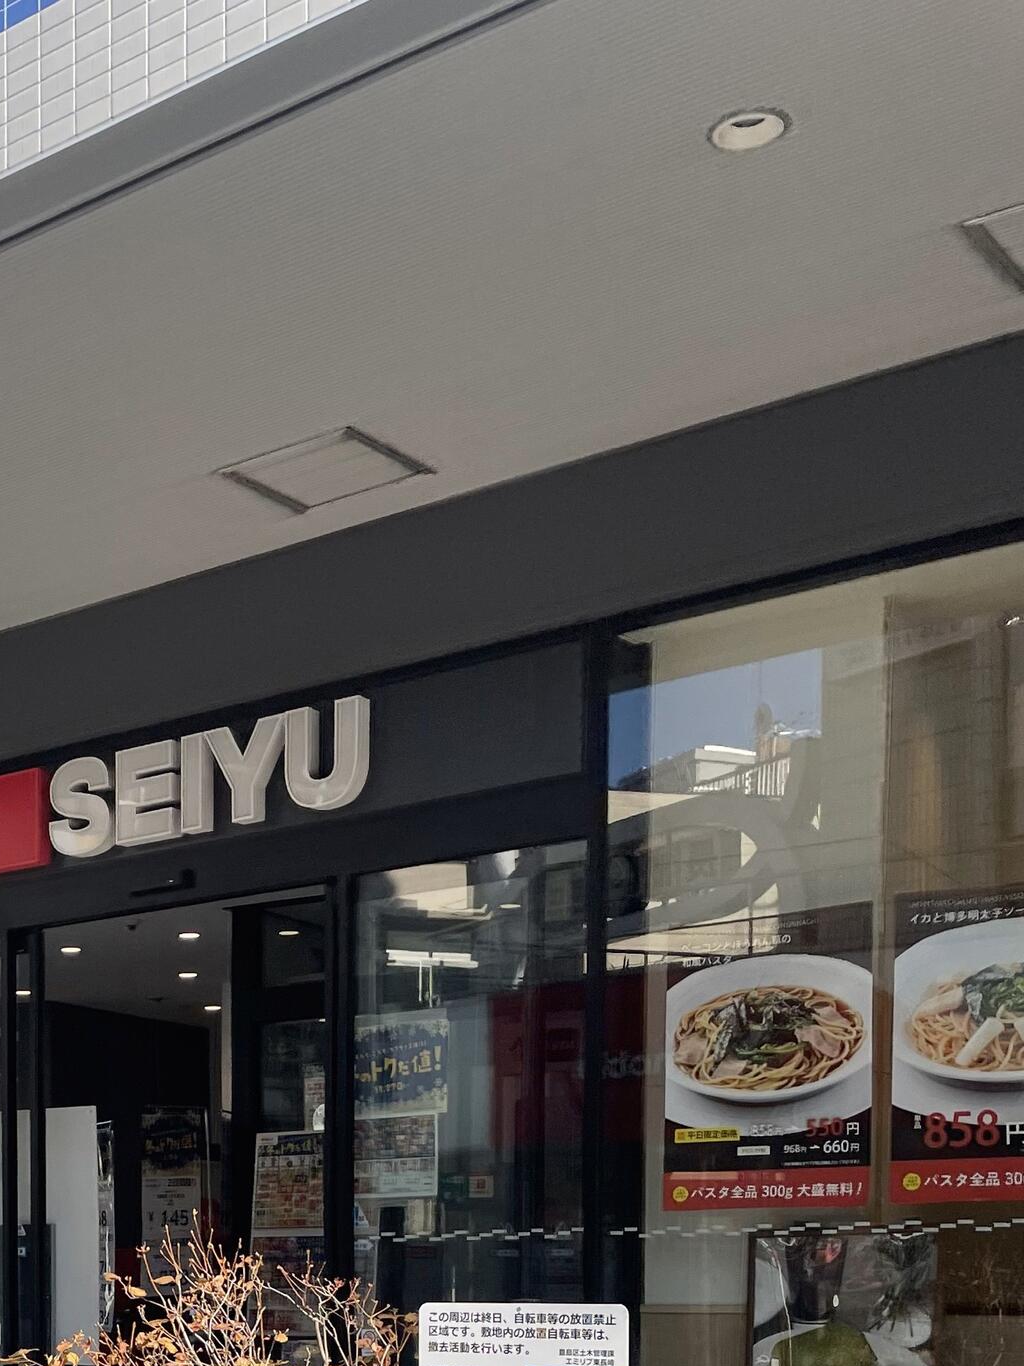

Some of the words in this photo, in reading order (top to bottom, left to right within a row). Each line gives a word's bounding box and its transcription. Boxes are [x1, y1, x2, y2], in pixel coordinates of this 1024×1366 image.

[49, 695, 370, 858] SEIYU
[823, 1140, 860, 1153] 660円
[924, 1172, 1001, 1187] パスタ全品
[1005, 1172, 1024, 1185] 30
[691, 1185, 758, 1199] パスタ全品
[762, 1185, 793, 1200] 300g
[428, 1311, 617, 1326] この周辺は終日、自転車等の放置禁止
